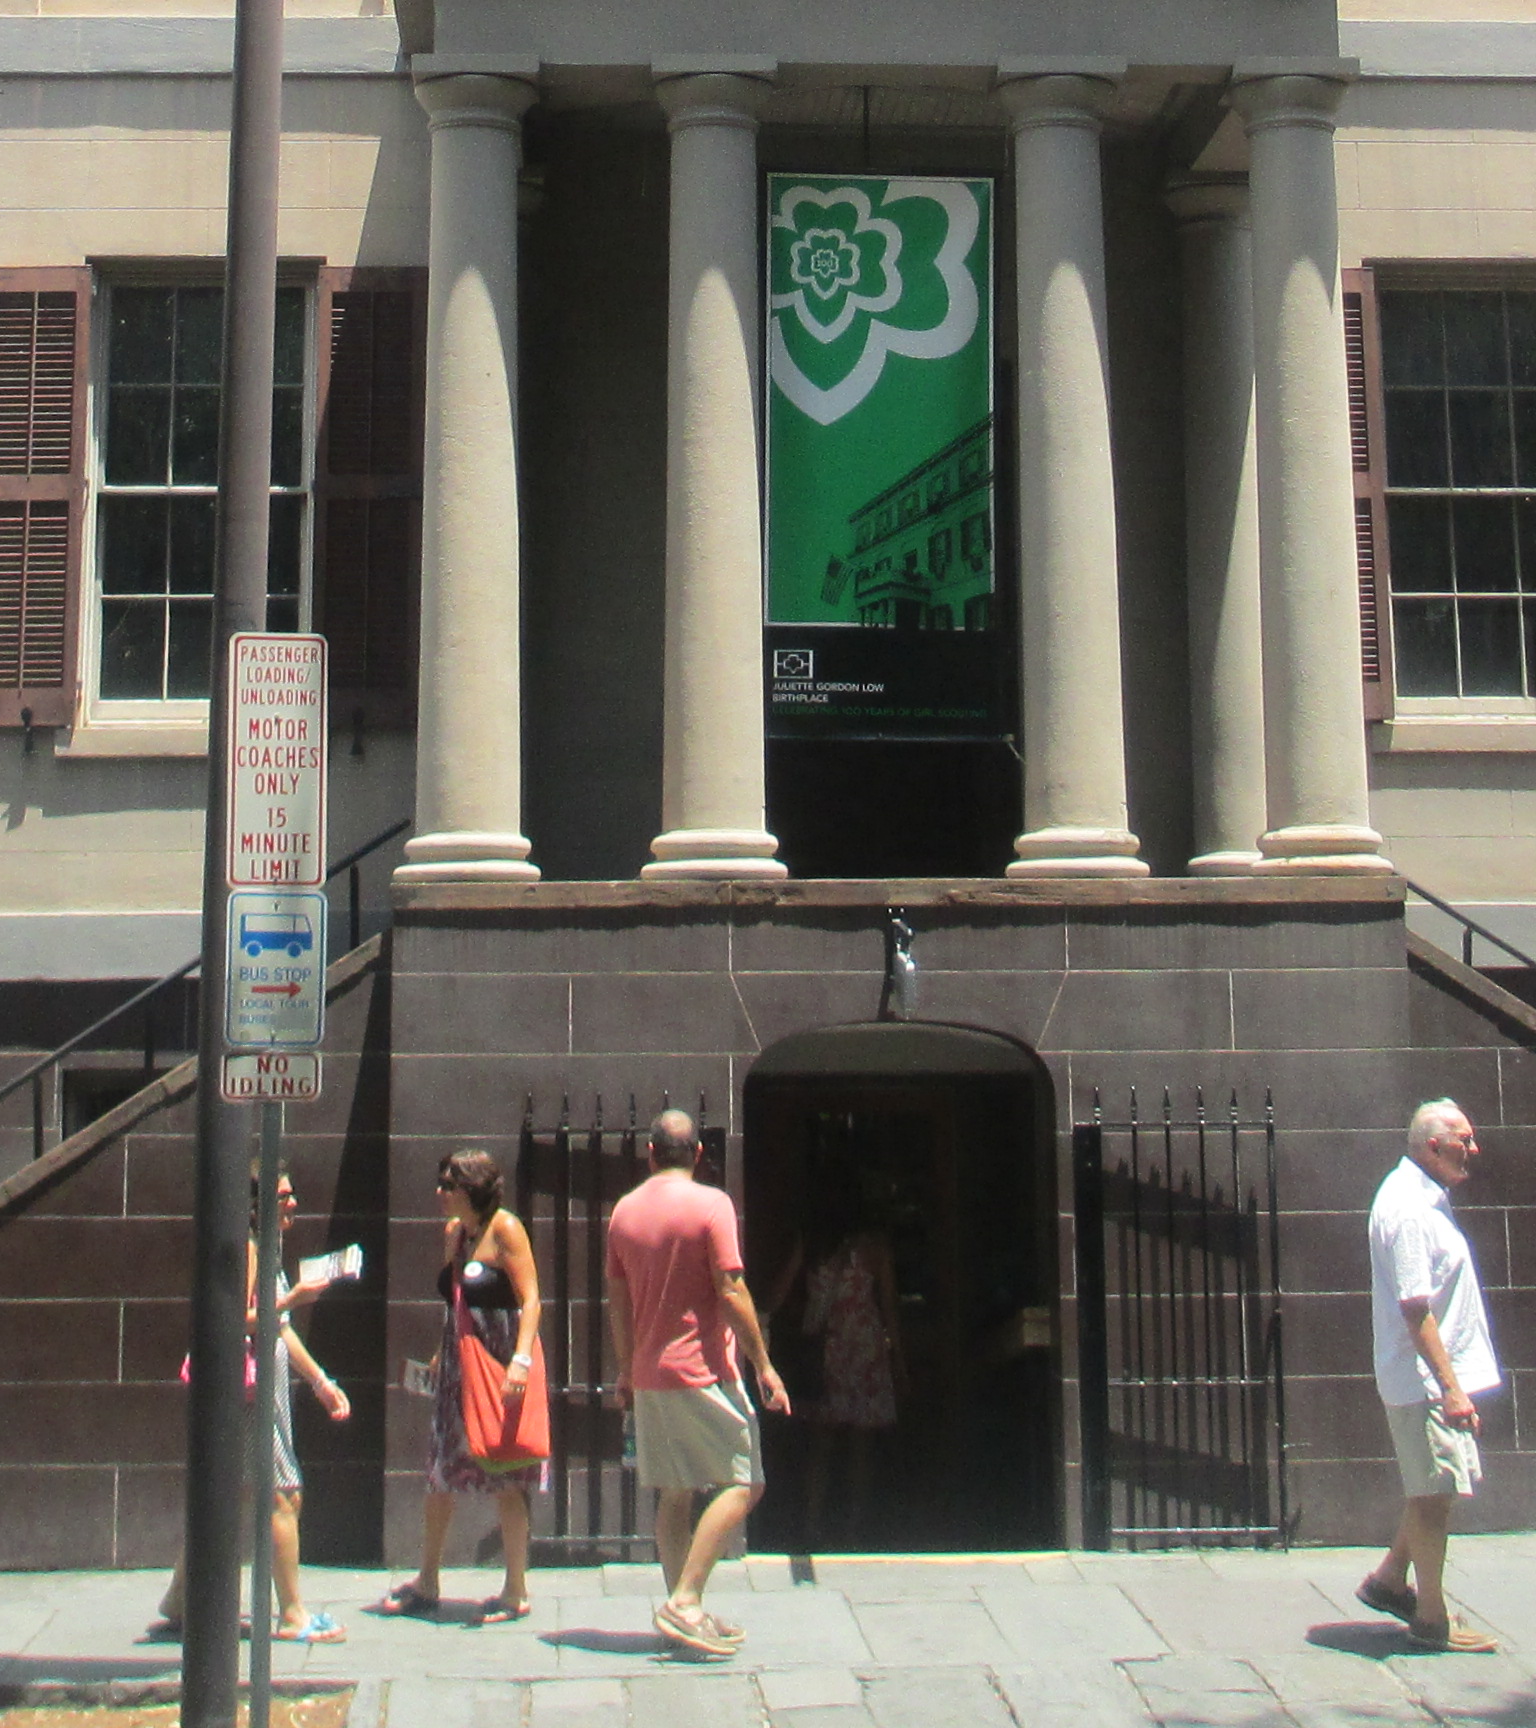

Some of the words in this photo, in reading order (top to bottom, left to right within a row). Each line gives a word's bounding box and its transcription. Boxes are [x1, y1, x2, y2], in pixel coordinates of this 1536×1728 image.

[240, 646, 319, 663] PASSENGER
[246, 666, 311, 684] LOADING/
[773, 682, 814, 691] JULIETTE
[816, 682, 860, 692] GORDON
[862, 683, 885, 692] LOW
[241, 689, 317, 706] UNLOADING
[772, 693, 829, 703] BIRTHPLACE
[248, 718, 308, 741] MOTOR
[237, 746, 320, 768] COACHES
[255, 773, 300, 795] ONLY
[267, 807, 287, 827] 15
[241, 833, 311, 853] MINUTE
[250, 859, 300, 879] LIMIT
[239, 967, 269, 981] BUS
[274, 967, 312, 982] STOP
[240, 999, 273, 1009] LOCAL
[279, 999, 310, 1009] TOUR
[257, 1055, 288, 1074] NO
[231, 1077, 311, 1095] IDLING
